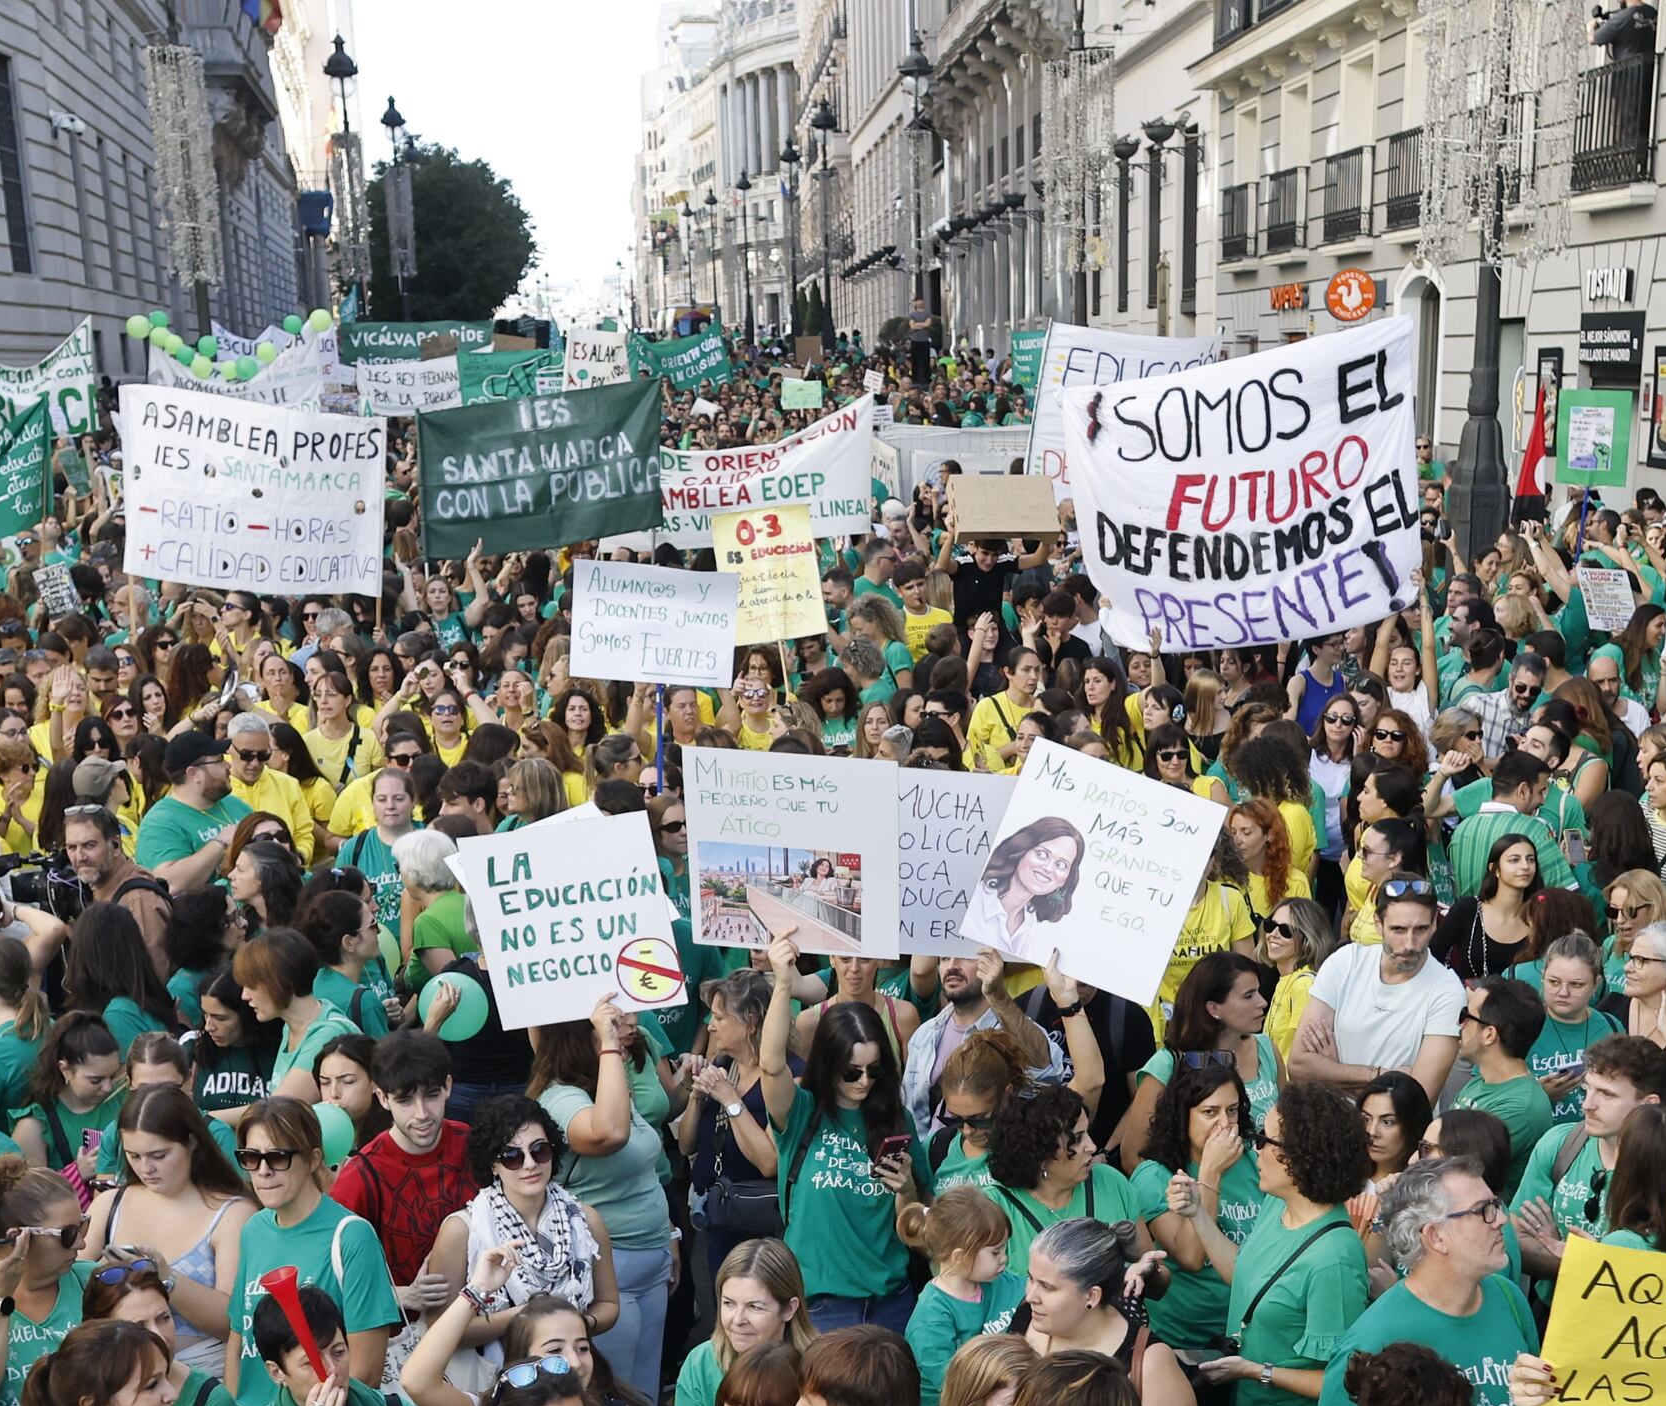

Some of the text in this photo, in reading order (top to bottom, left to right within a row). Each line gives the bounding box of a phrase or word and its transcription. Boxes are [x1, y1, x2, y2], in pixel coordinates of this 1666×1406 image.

[1586, 267, 1628, 302] TOSTADO
[1587, 330, 1604, 342] MEJOR
[395, 371, 415, 387] REY
[1336, 349, 1405, 425] EL
[373, 387, 414, 406] POR LA
[517, 398, 574, 430] IES
[142, 401, 383, 463] ASAMBLEA PROFES
[153, 444, 363, 492] IES SANTAMARCA
[662, 454, 693, 473] DE
[683, 459, 781, 487] CALIDAD
[436, 455, 662, 520] CON LA PÚBLICA
[761, 472, 826, 503] EOEP
[1165, 434, 1369, 532] FUTURO
[735, 513, 784, 546] 0-3
[1096, 496, 1353, 583] DEFENDEMOS
[1363, 468, 1420, 536] EL
[279, 550, 380, 584] EDUCATIVA
[726, 541, 814, 565] ES EDUCACIÓN
[1134, 540, 1407, 649] PRESENTE!
[589, 598, 668, 621] DOCENTES
[675, 609, 729, 630] JUNTOS
[578, 620, 718, 671] SOMOS FUERTES
[728, 768, 839, 794] PATIO ES MÁS
[699, 789, 840, 814] PEQUEÑO QUE TU
[899, 784, 986, 822] MUCHA
[1083, 781, 1151, 818] RATIOS
[719, 813, 782, 838] ÁTICO
[899, 825, 992, 856] OLICÍA
[1087, 811, 1144, 847] MÁS
[486, 851, 533, 888] LA
[899, 859, 950, 886] OCA
[1087, 839, 1185, 883] GRANDES
[498, 866, 658, 916] EDUCACIÓN
[901, 888, 971, 911] DUCA
[1094, 870, 1174, 908] QUE TU
[501, 911, 638, 953] NO ES UN
[1100, 904, 1148, 934] EGO.
[506, 952, 613, 989] NEGOCIO
[1556, 1369, 1654, 1403] LAS
